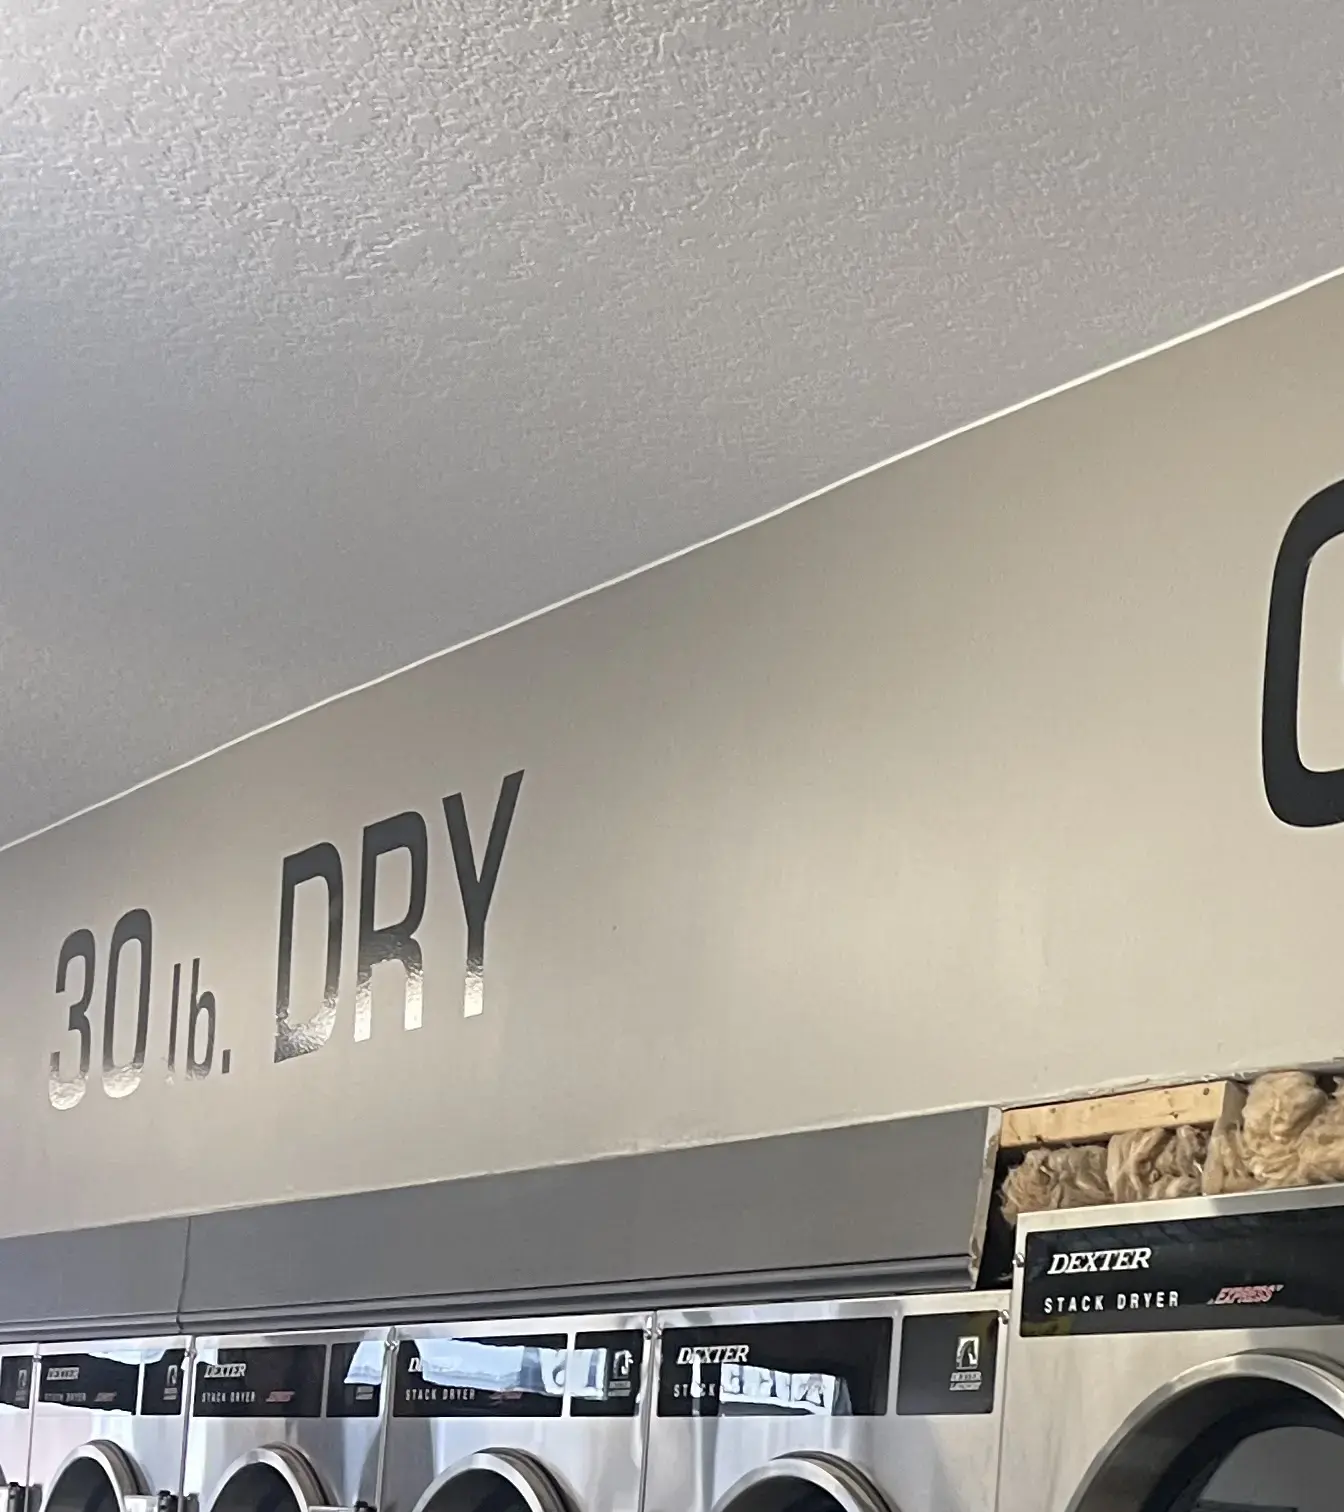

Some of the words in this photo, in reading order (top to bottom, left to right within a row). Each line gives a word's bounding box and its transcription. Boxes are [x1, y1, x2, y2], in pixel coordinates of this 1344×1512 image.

[48, 907, 153, 1111] 30
[165, 957, 231, 1086] lb.
[273, 768, 525, 1063] DRY
[1046, 1247, 1153, 1275] DEXTER
[1043, 1294, 1104, 1315] STACK
[1116, 1290, 1180, 1311] DRYER
[676, 1344, 750, 1365] DEXTER
[405, 1388, 437, 1401] STACK
[442, 1388, 476, 1401] DRYER
[673, 1383, 716, 1398] STCK
